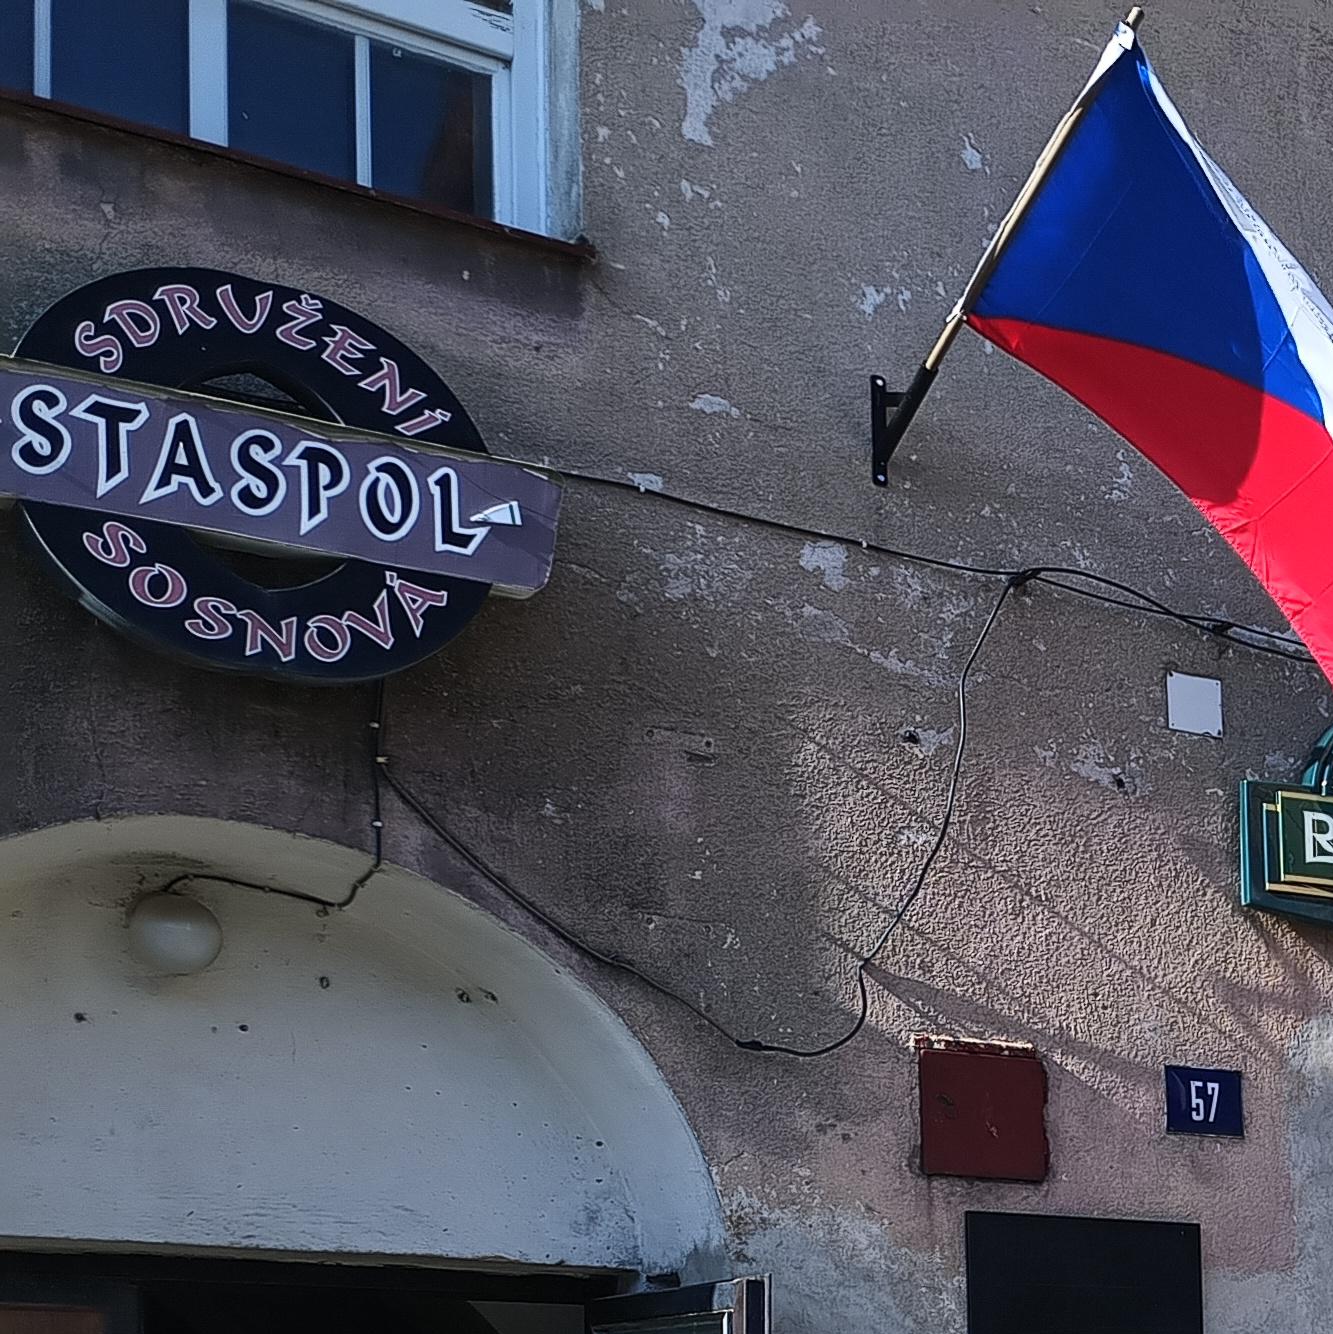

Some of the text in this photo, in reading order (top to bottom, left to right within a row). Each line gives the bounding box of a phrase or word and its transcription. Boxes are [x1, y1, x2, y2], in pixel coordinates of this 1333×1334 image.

[75, 284, 450, 435] SDRUŽENÍ
[11, 384, 490, 556] STASPOL
[83, 521, 447, 662] SOSNOVÁ
[1189, 1080, 1220, 1122] 57
